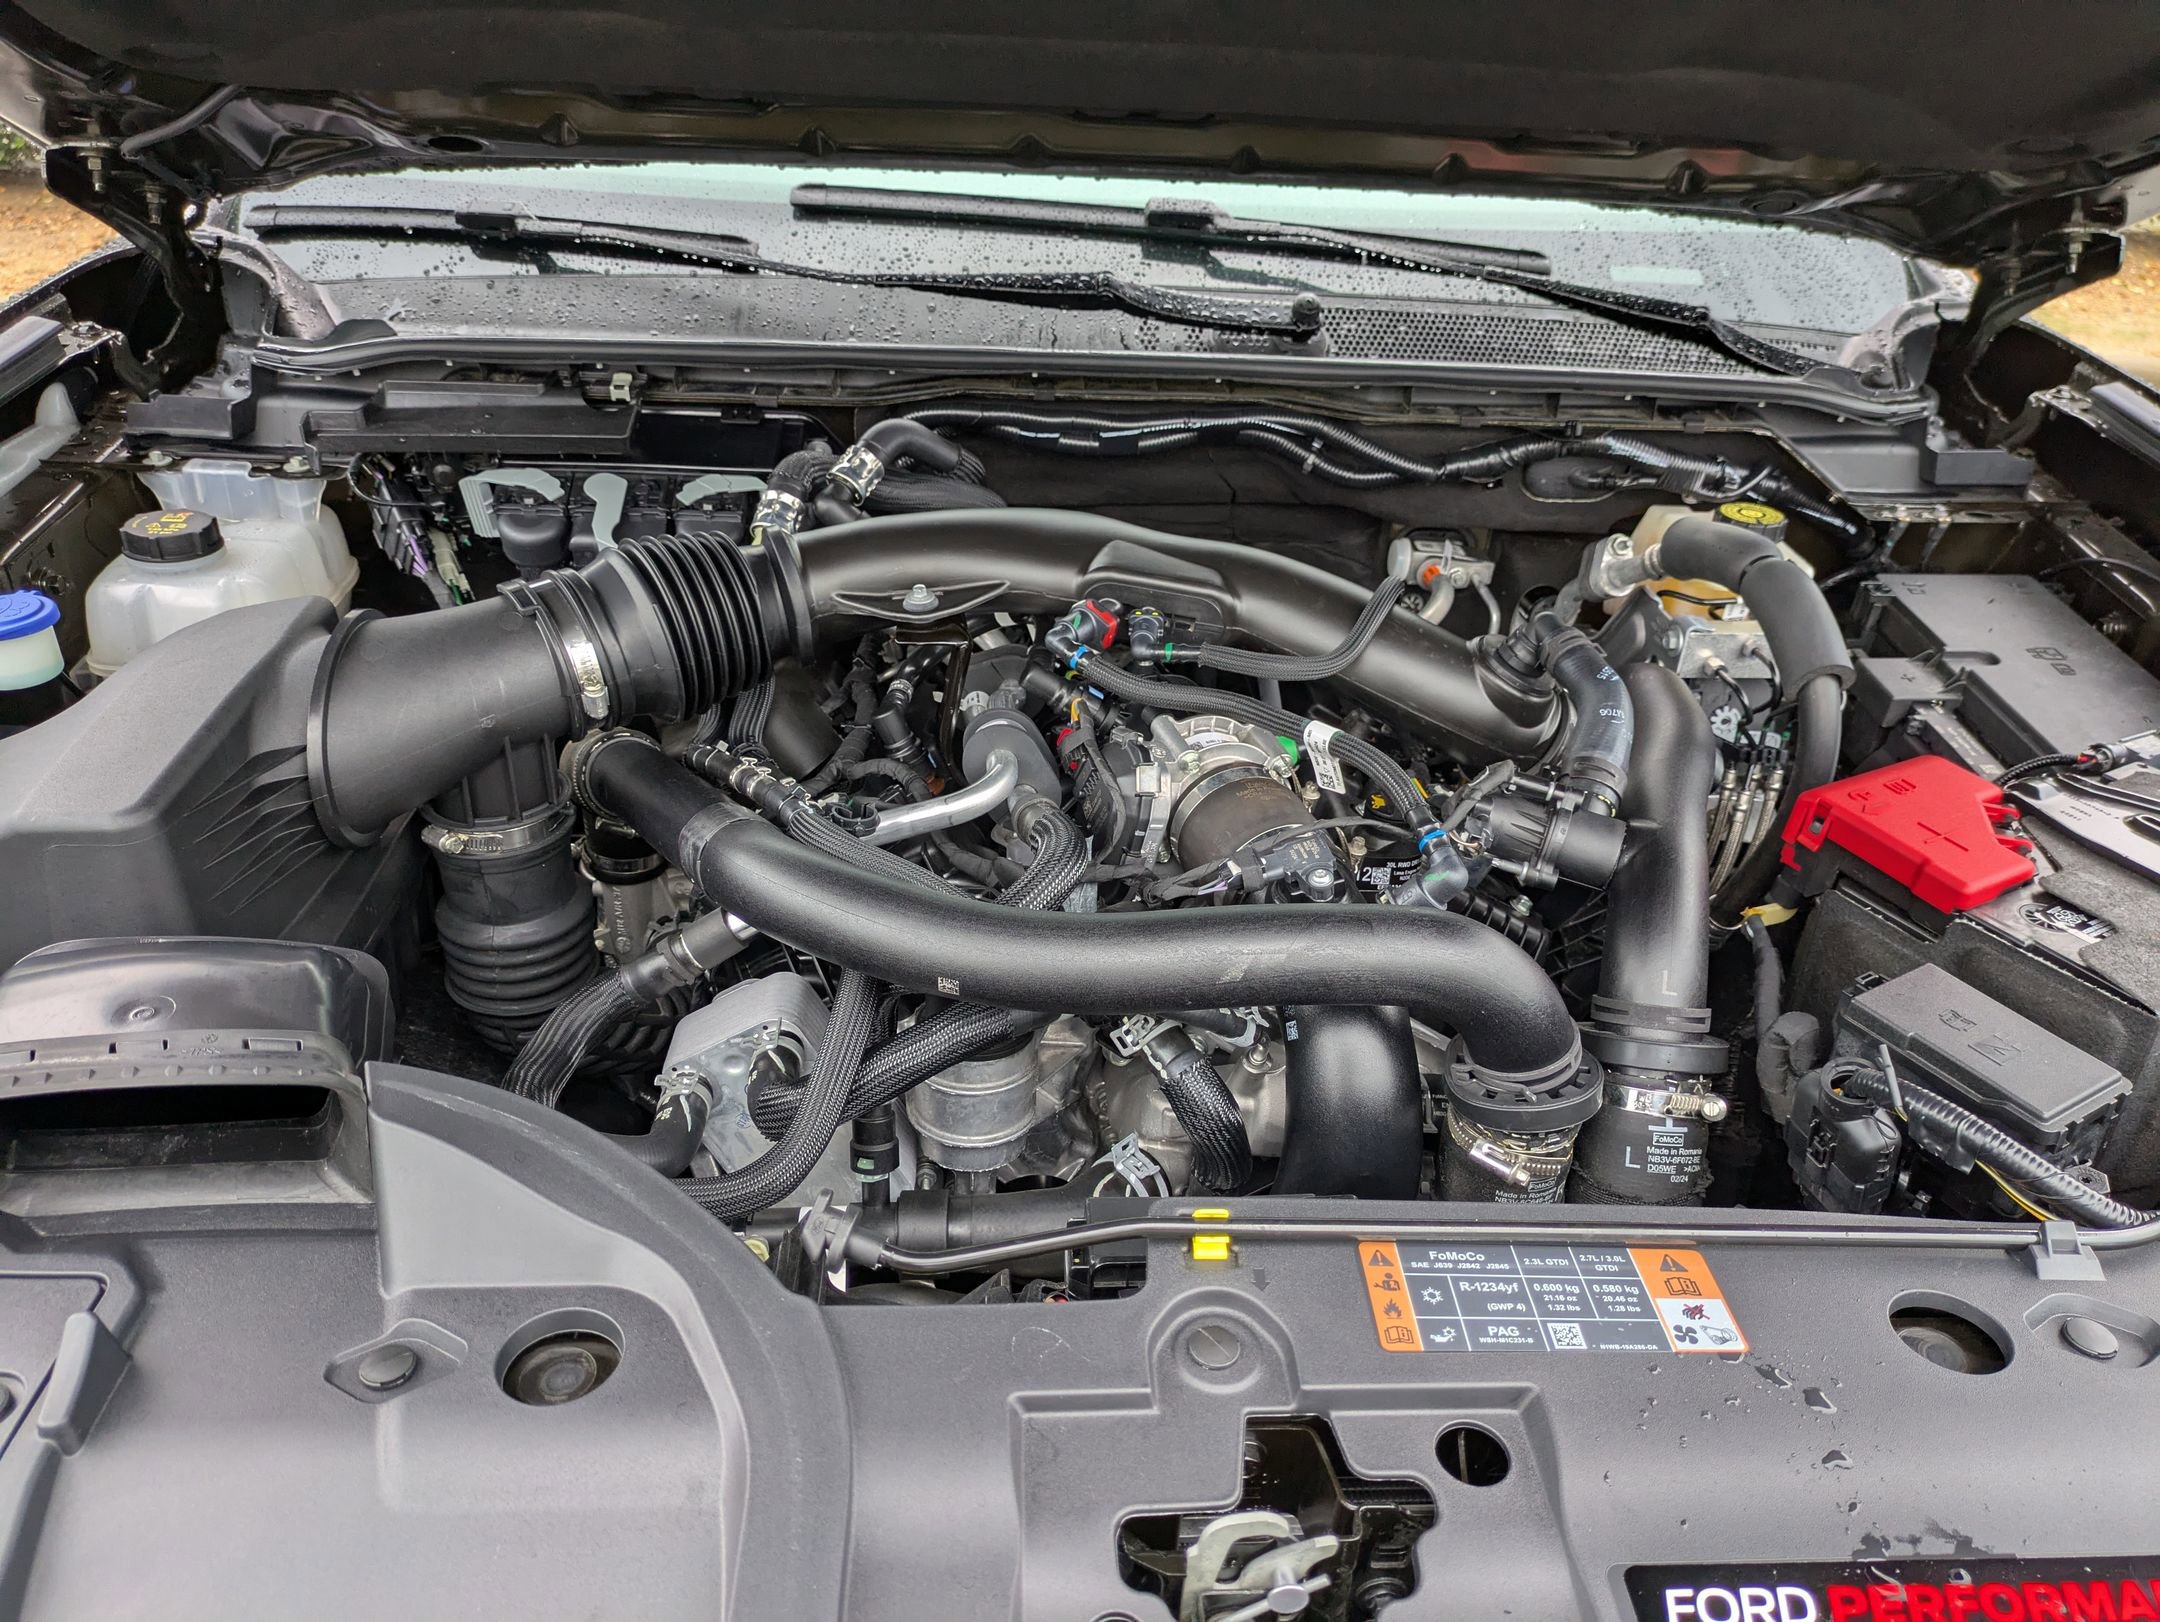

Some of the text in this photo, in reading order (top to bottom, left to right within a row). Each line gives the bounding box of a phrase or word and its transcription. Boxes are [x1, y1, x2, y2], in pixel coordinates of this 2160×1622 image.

[1662, 969, 1678, 996] L
[1654, 1135, 1683, 1144] FoMoCo
[1646, 1146, 1669, 1155] Made
[1625, 1146, 1641, 1169] L
[1670, 1175, 1689, 1183] 02/24
[1495, 1189, 1518, 1199] Made
[1428, 1250, 1486, 1261] FoMoCo
[1579, 1254, 1600, 1262] 2.7L
[1605, 1255, 1626, 1263] 3.0L
[1410, 1261, 1430, 1269] SAE
[1545, 1258, 1569, 1266] GTDI
[1594, 1264, 1619, 1272] GTDI
[1459, 1281, 1519, 1295] R-1234yf
[1533, 1283, 1580, 1294] 0.600 kg
[1592, 1284, 1640, 1295] 0.580 kg
[1543, 1294, 1566, 1302] 21.16
[1602, 1295, 1626, 1303] 20.46
[1487, 1302, 1526, 1313] (GWP 4)
[1566, 1304, 1581, 1312] lbs
[1607, 1304, 1641, 1313] 1.28 lbs
[1487, 1325, 1520, 1336] PAG
[1665, 1579, 2160, 1622] FORD PERFORMA
